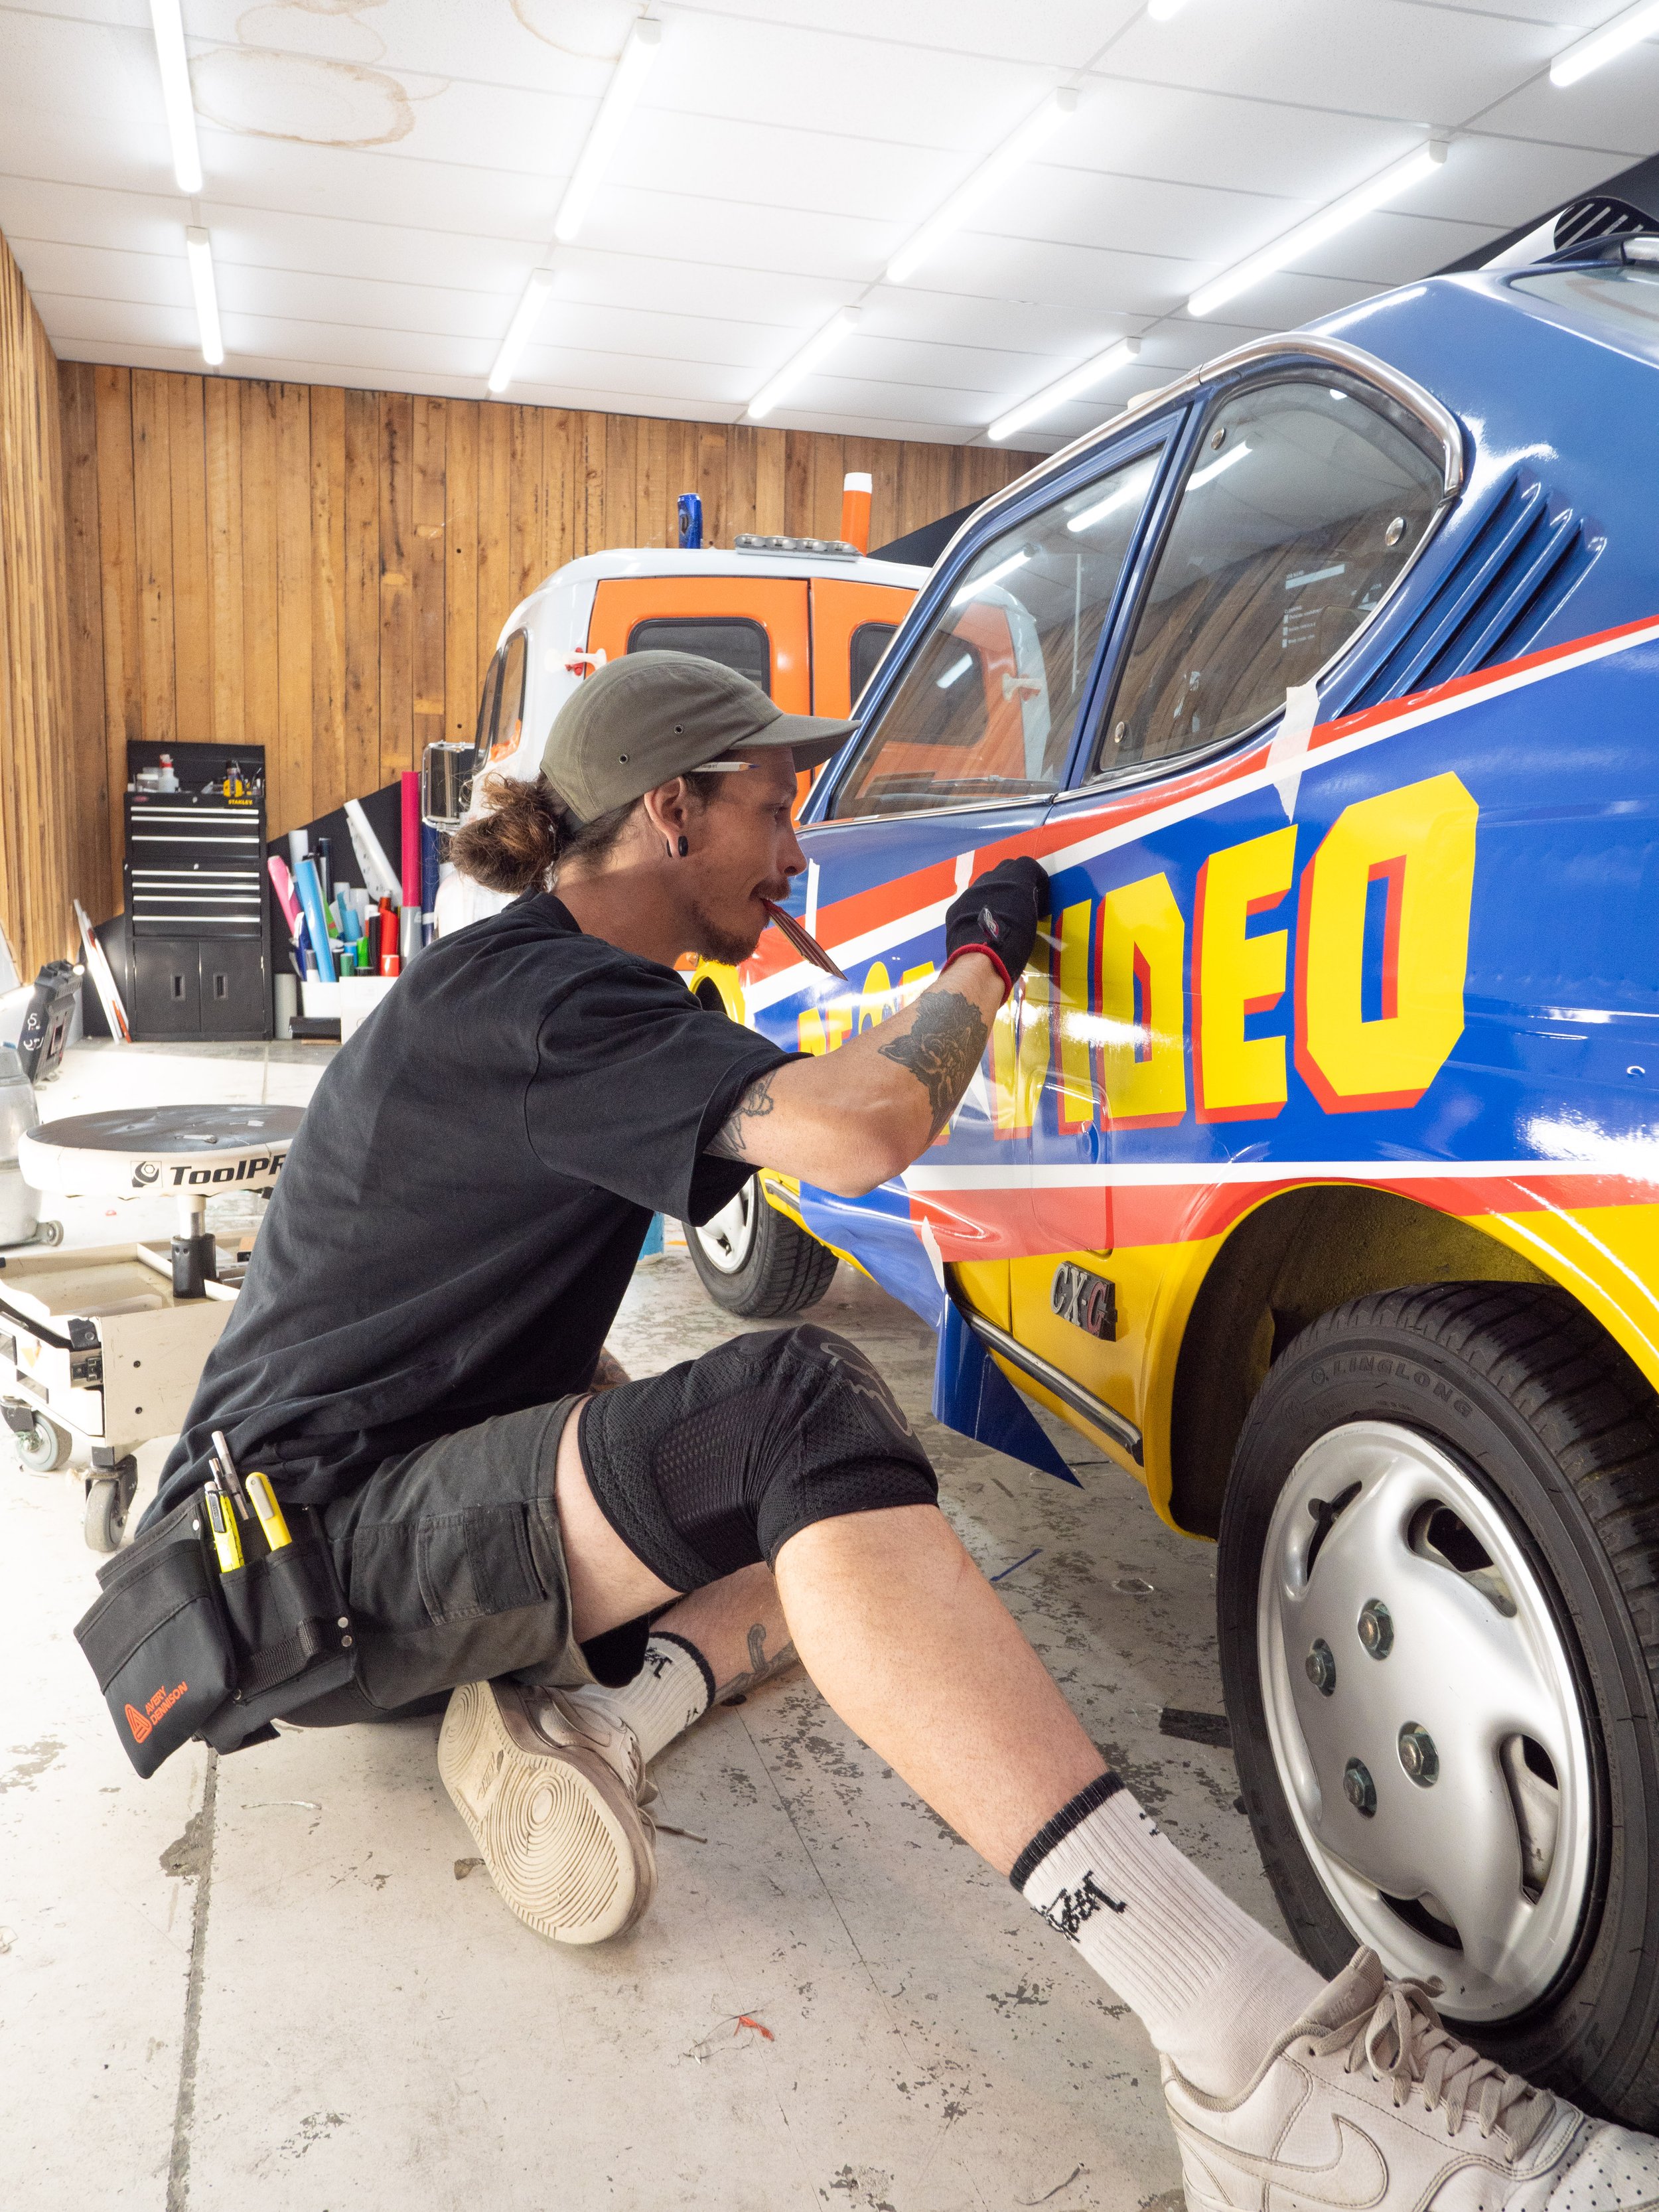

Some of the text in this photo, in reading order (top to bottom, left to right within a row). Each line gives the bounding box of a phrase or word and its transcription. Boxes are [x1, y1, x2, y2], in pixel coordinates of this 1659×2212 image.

[171, 1153, 287, 1185] ToolPR
[1333, 1356, 1473, 1418] LINGLONG
[145, 1684, 167, 1716] AVERY
[149, 1680, 188, 1726] DENNISON
